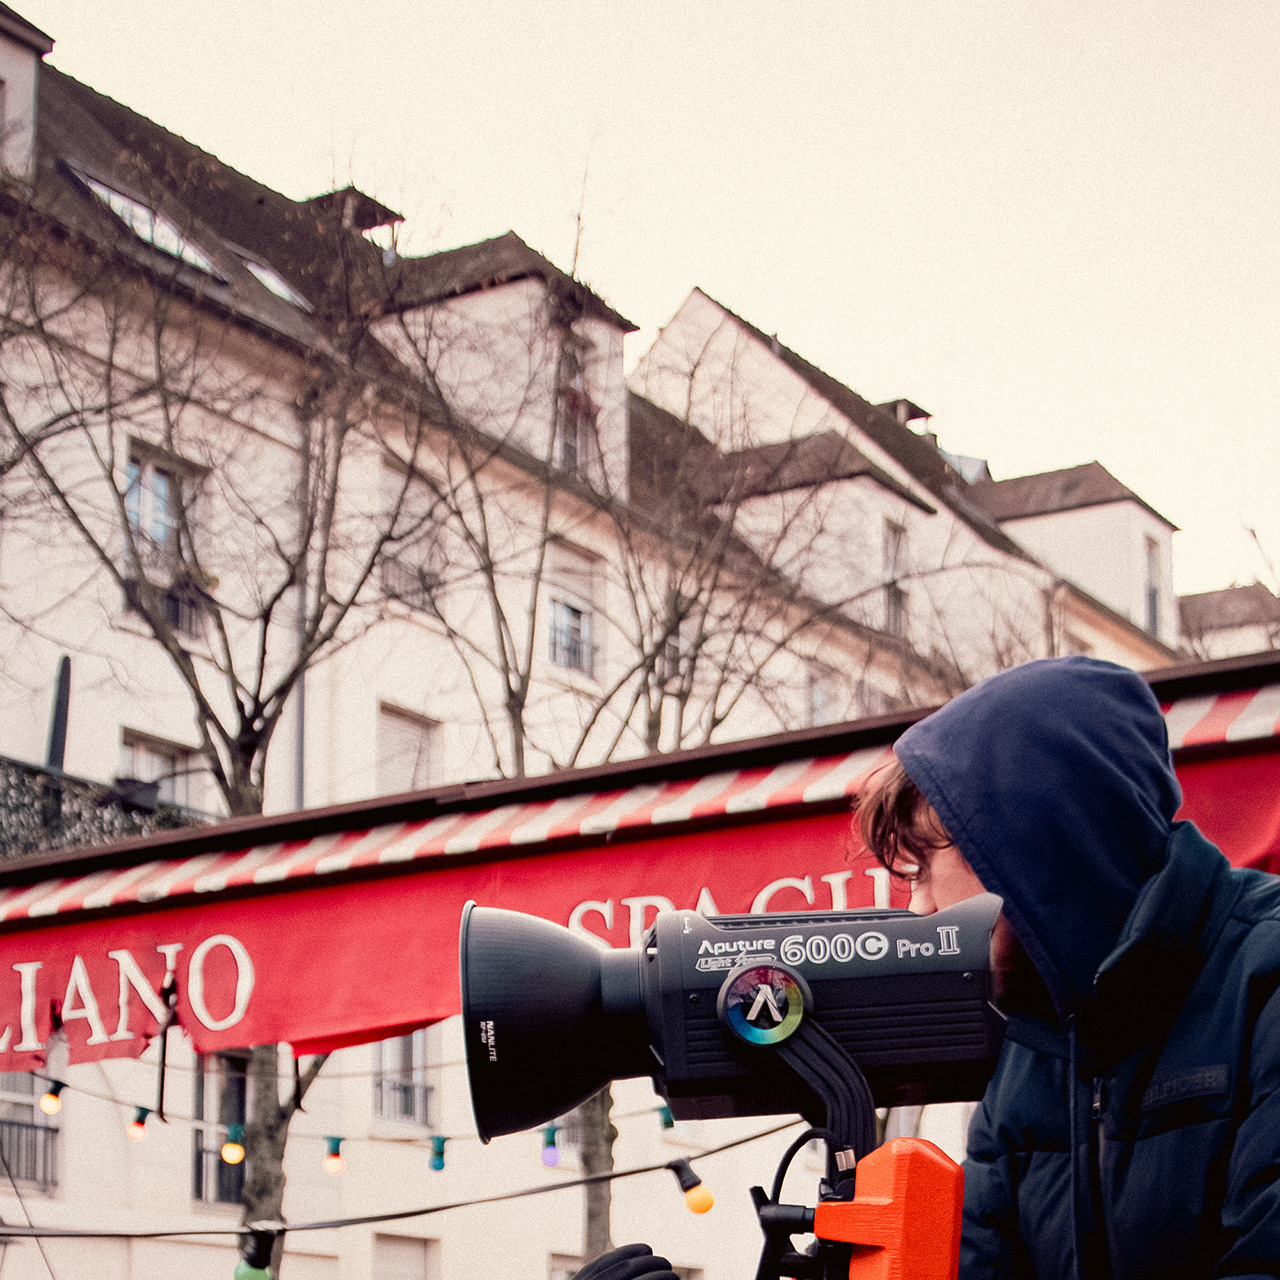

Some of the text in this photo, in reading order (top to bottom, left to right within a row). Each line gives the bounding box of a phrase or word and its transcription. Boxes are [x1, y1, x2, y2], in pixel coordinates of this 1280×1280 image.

[698, 938, 775, 956] Aputure
[896, 938, 935, 958] Pro
[937, 926, 960, 955] II
[486, 1020, 497, 1061] NANLITE
